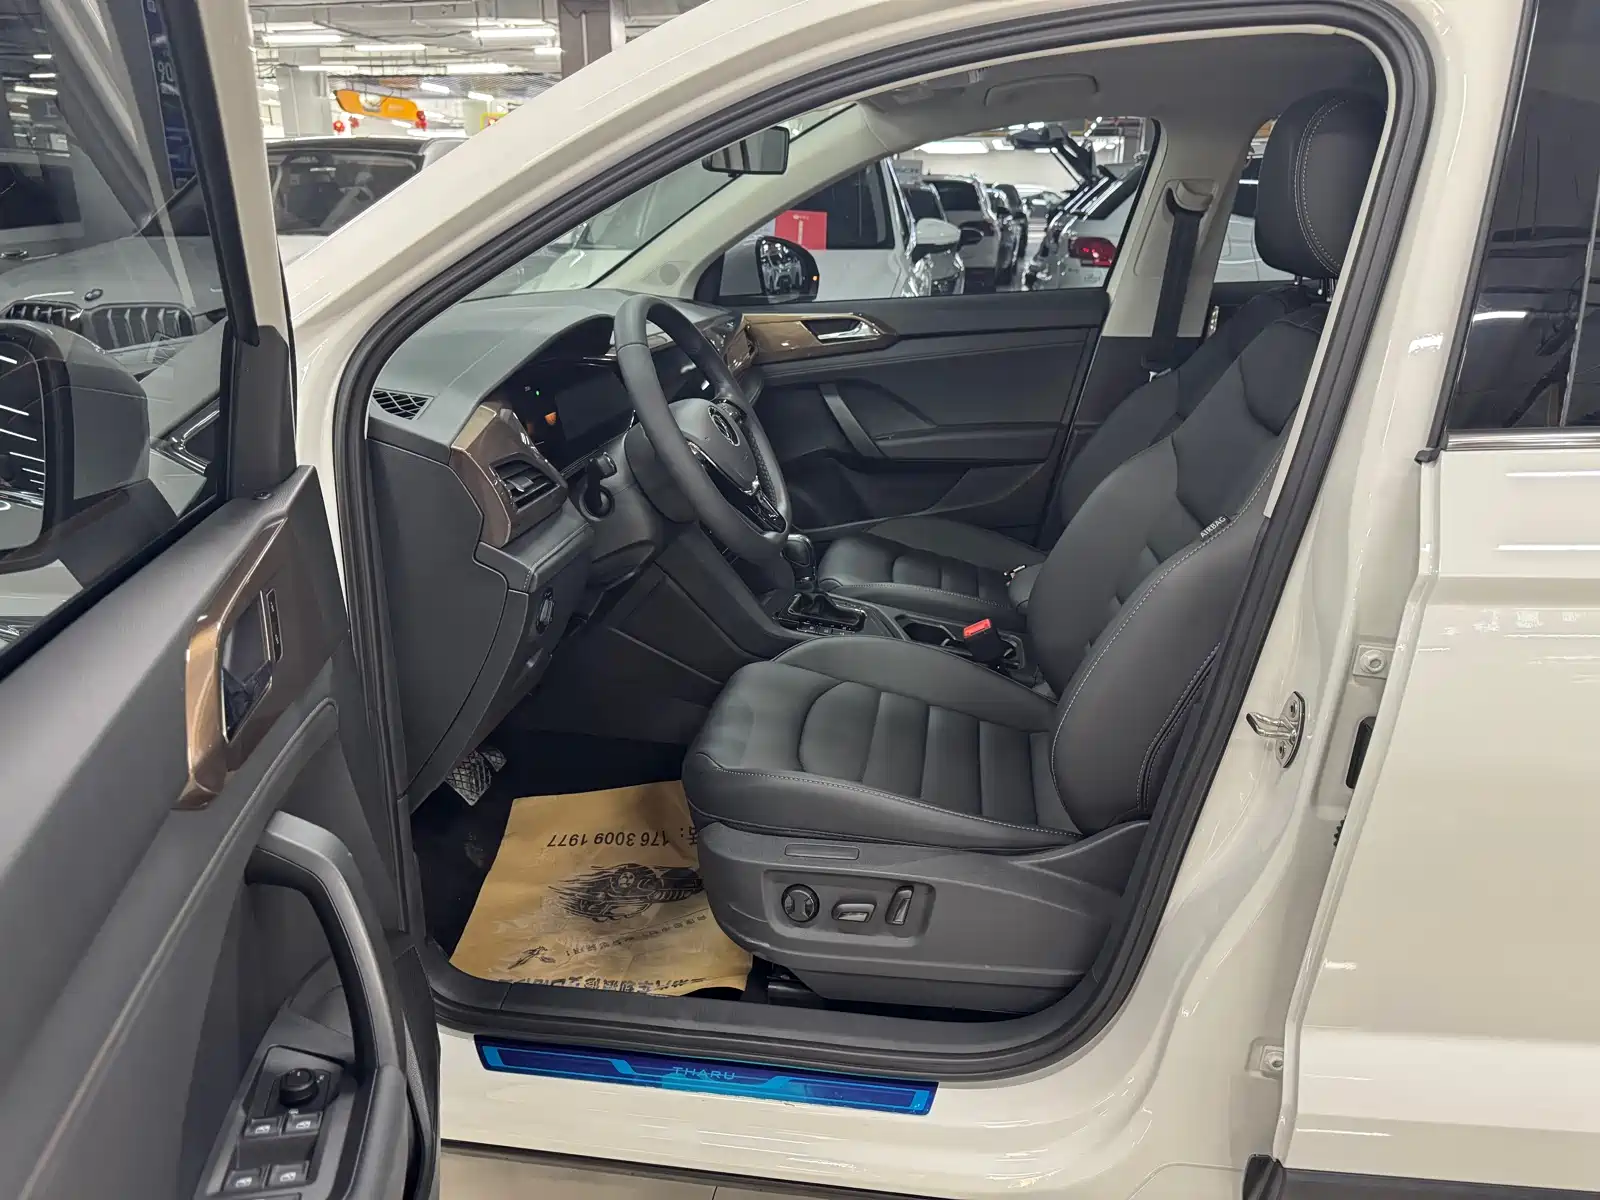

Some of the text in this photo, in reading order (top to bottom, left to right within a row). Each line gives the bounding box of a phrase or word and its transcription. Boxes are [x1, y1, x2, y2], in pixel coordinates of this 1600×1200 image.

[1200, 516, 1226, 538] AIRBAG
[547, 832, 588, 847] 1977
[593, 831, 636, 847] 3009
[640, 830, 671, 847] 176
[673, 1066, 735, 1080] THARU
